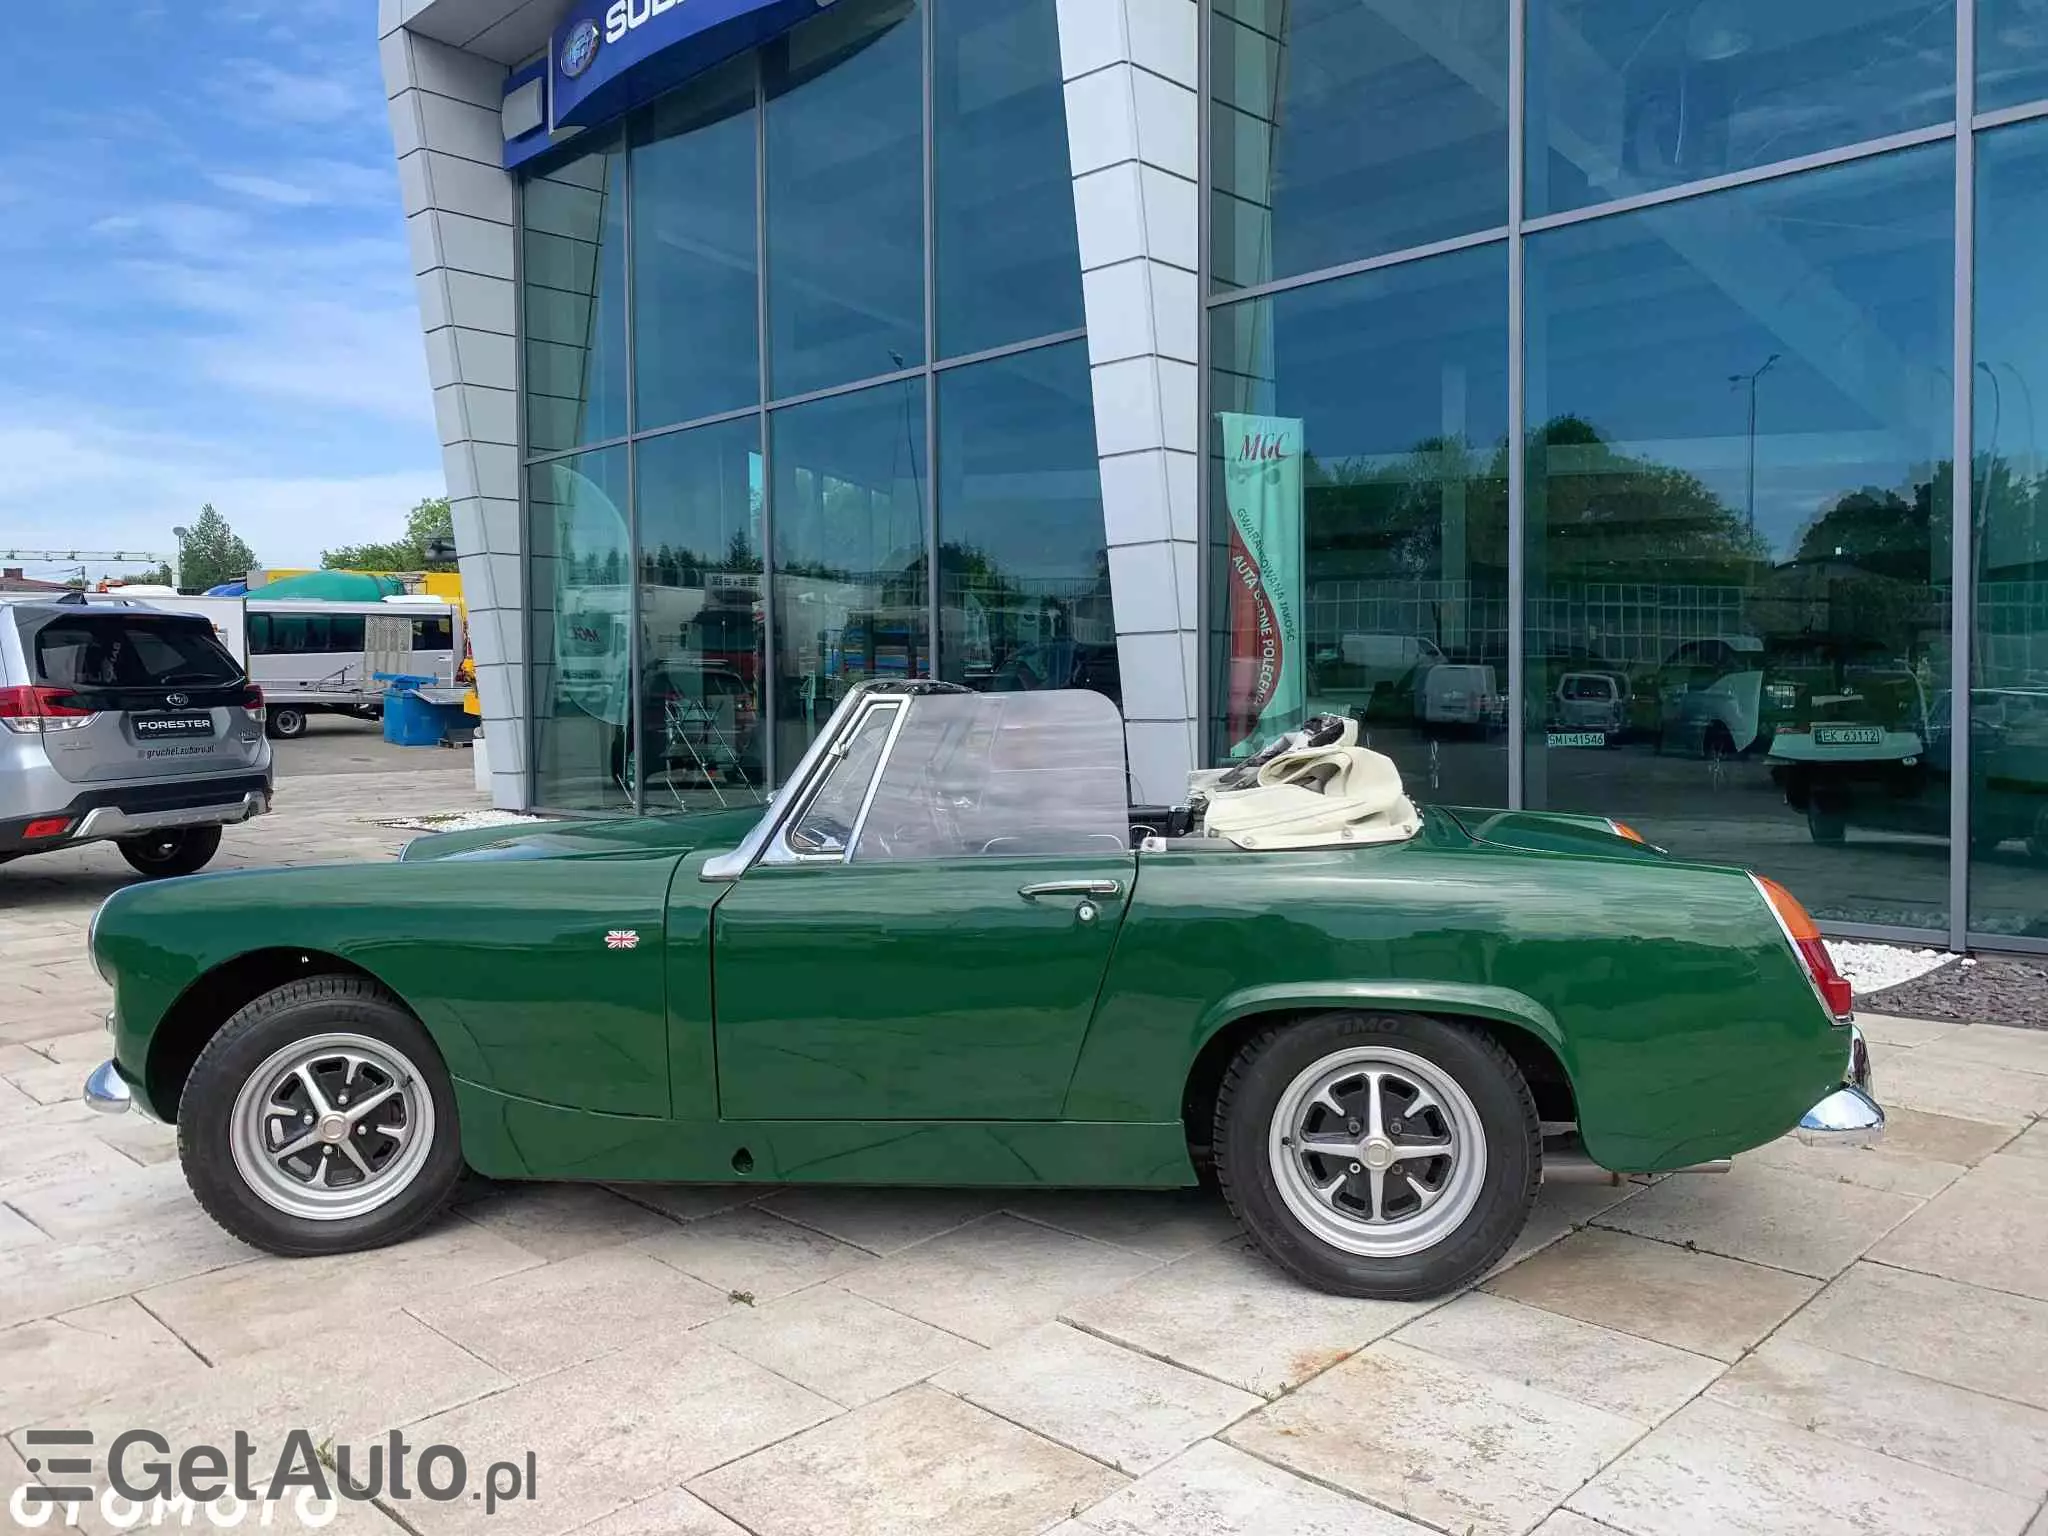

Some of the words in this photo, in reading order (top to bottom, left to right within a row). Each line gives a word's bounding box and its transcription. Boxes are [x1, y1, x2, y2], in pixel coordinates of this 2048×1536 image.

[605, 0, 685, 44] SU
[1239, 432, 1295, 462] MGC
[1237, 508, 1285, 600] GWARAOWANA
[1232, 555, 1260, 590] AUTA
[138, 719, 211, 731] FORESTER
